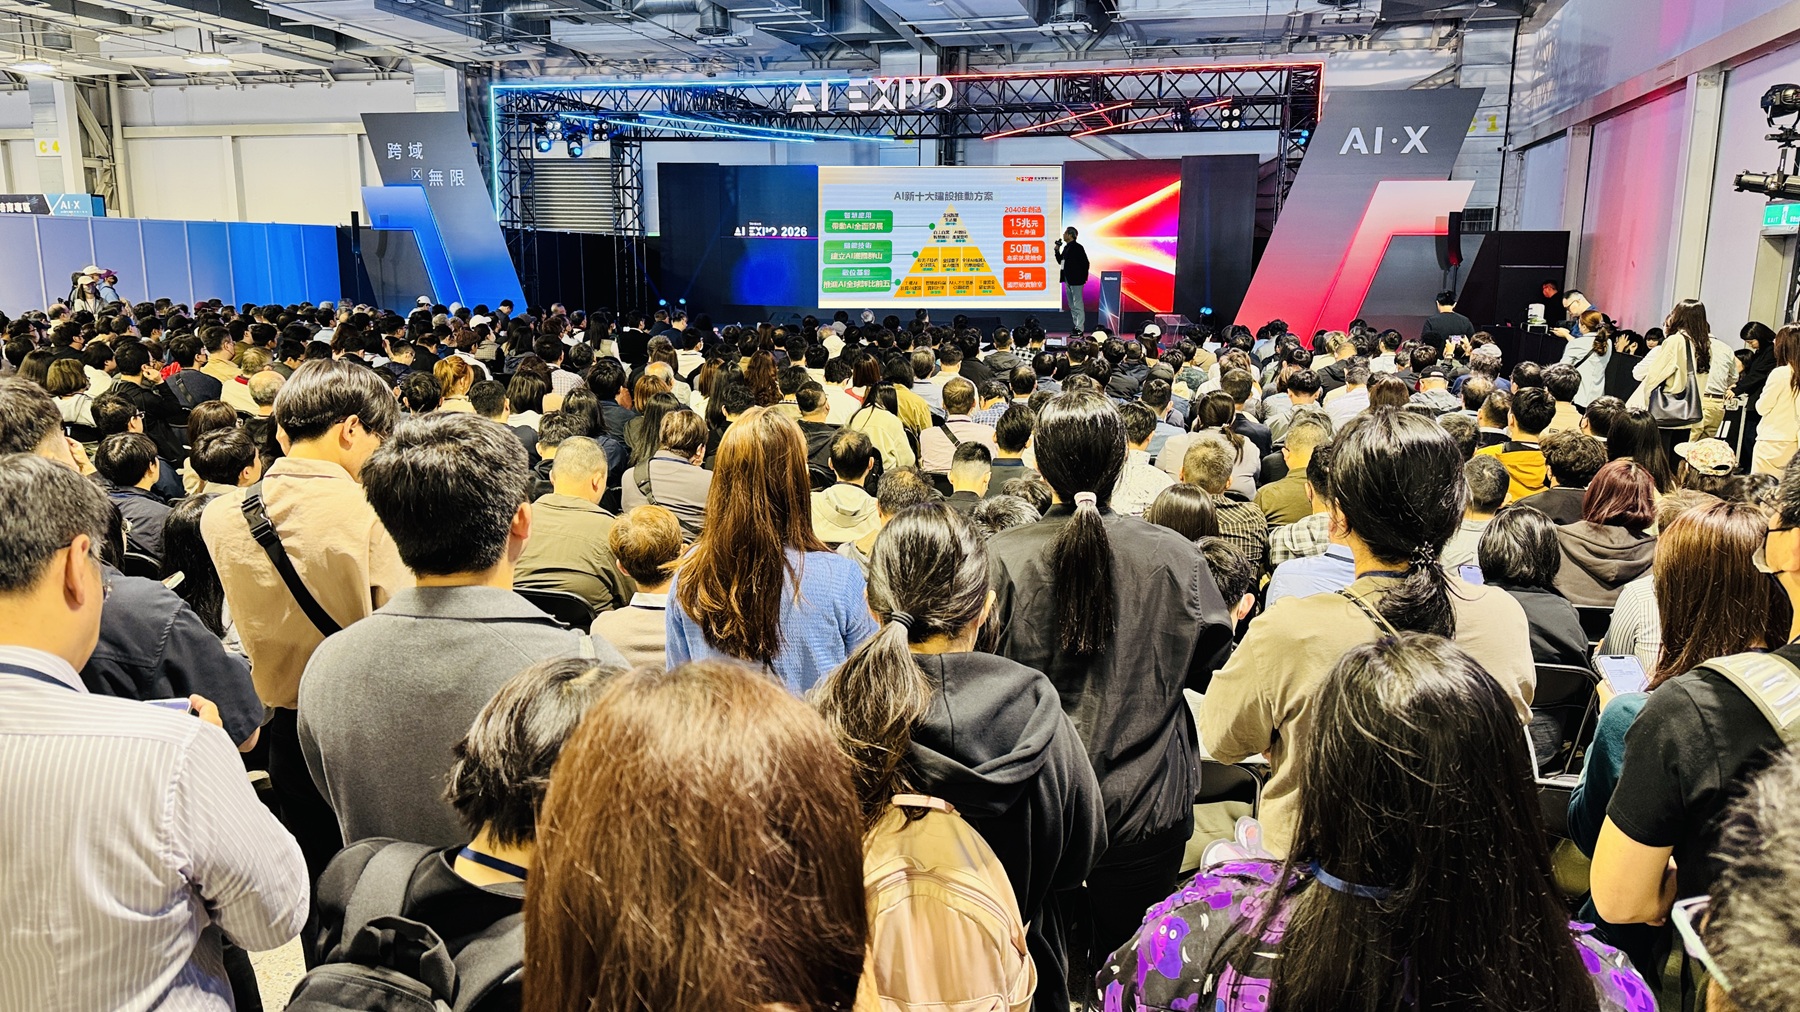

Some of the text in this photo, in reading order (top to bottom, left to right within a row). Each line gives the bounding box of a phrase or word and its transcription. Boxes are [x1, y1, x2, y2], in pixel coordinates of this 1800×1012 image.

[791, 77, 953, 112] AI EXPO
[387, 141, 424, 160] 跨域
[428, 168, 466, 187] 無限
[893, 191, 994, 202] AI新十大建設推動方案
[1010, 217, 1039, 228] 15兆元
[734, 226, 808, 237] AI EXPO 2026
